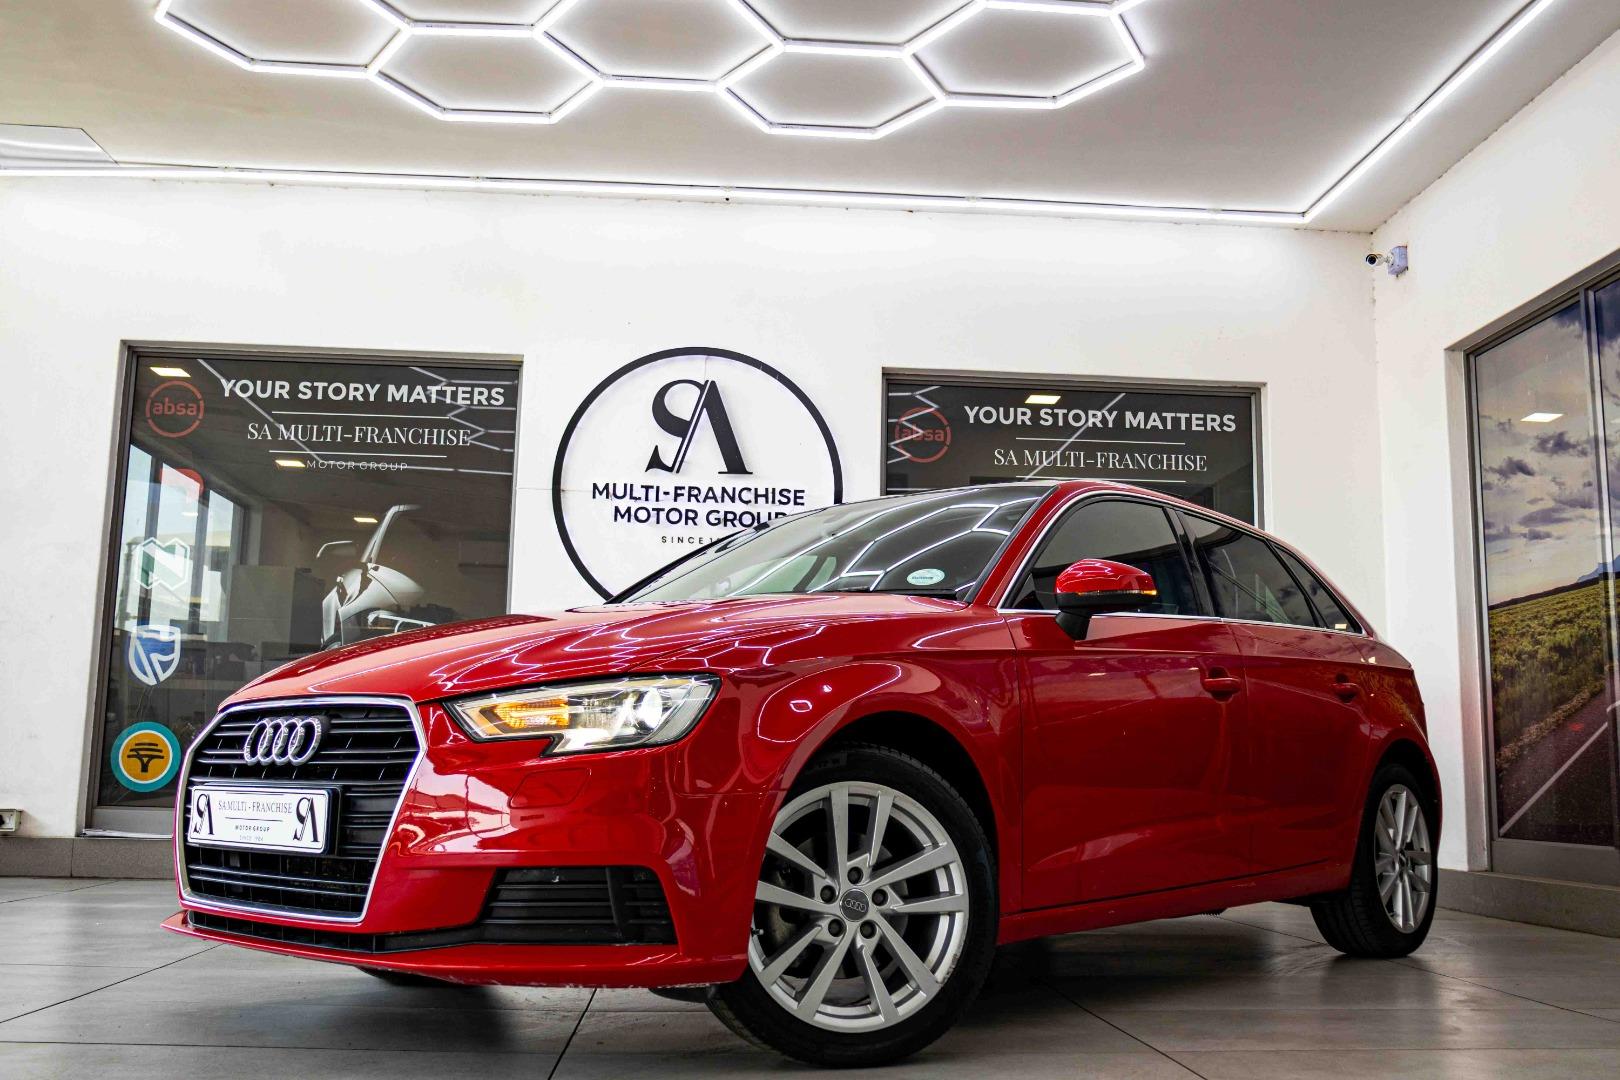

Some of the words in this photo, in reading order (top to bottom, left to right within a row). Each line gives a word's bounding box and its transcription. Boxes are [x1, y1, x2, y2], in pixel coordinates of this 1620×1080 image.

[220, 379, 290, 399] YOUR
[297, 381, 381, 402] STORY
[387, 384, 505, 406] MATTERS
[152, 397, 198, 416] absa
[964, 405, 1032, 426] YOUR
[1039, 408, 1118, 428] STORY
[1125, 411, 1237, 433] MATTERS
[247, 422, 273, 440] SA
[277, 423, 471, 446] MULTI-FRANCHISE
[901, 423, 946, 442] absa
[306, 460, 355, 470] MOTOR
[359, 461, 408, 471] GROUP
[994, 448, 1018, 466] SA
[1024, 449, 1208, 472] MULTI-FRANCHISE
[592, 482, 806, 506] MULTI-FRANCHISE
[613, 506, 698, 526] MOTOR
[661, 536, 704, 544] SINCE
